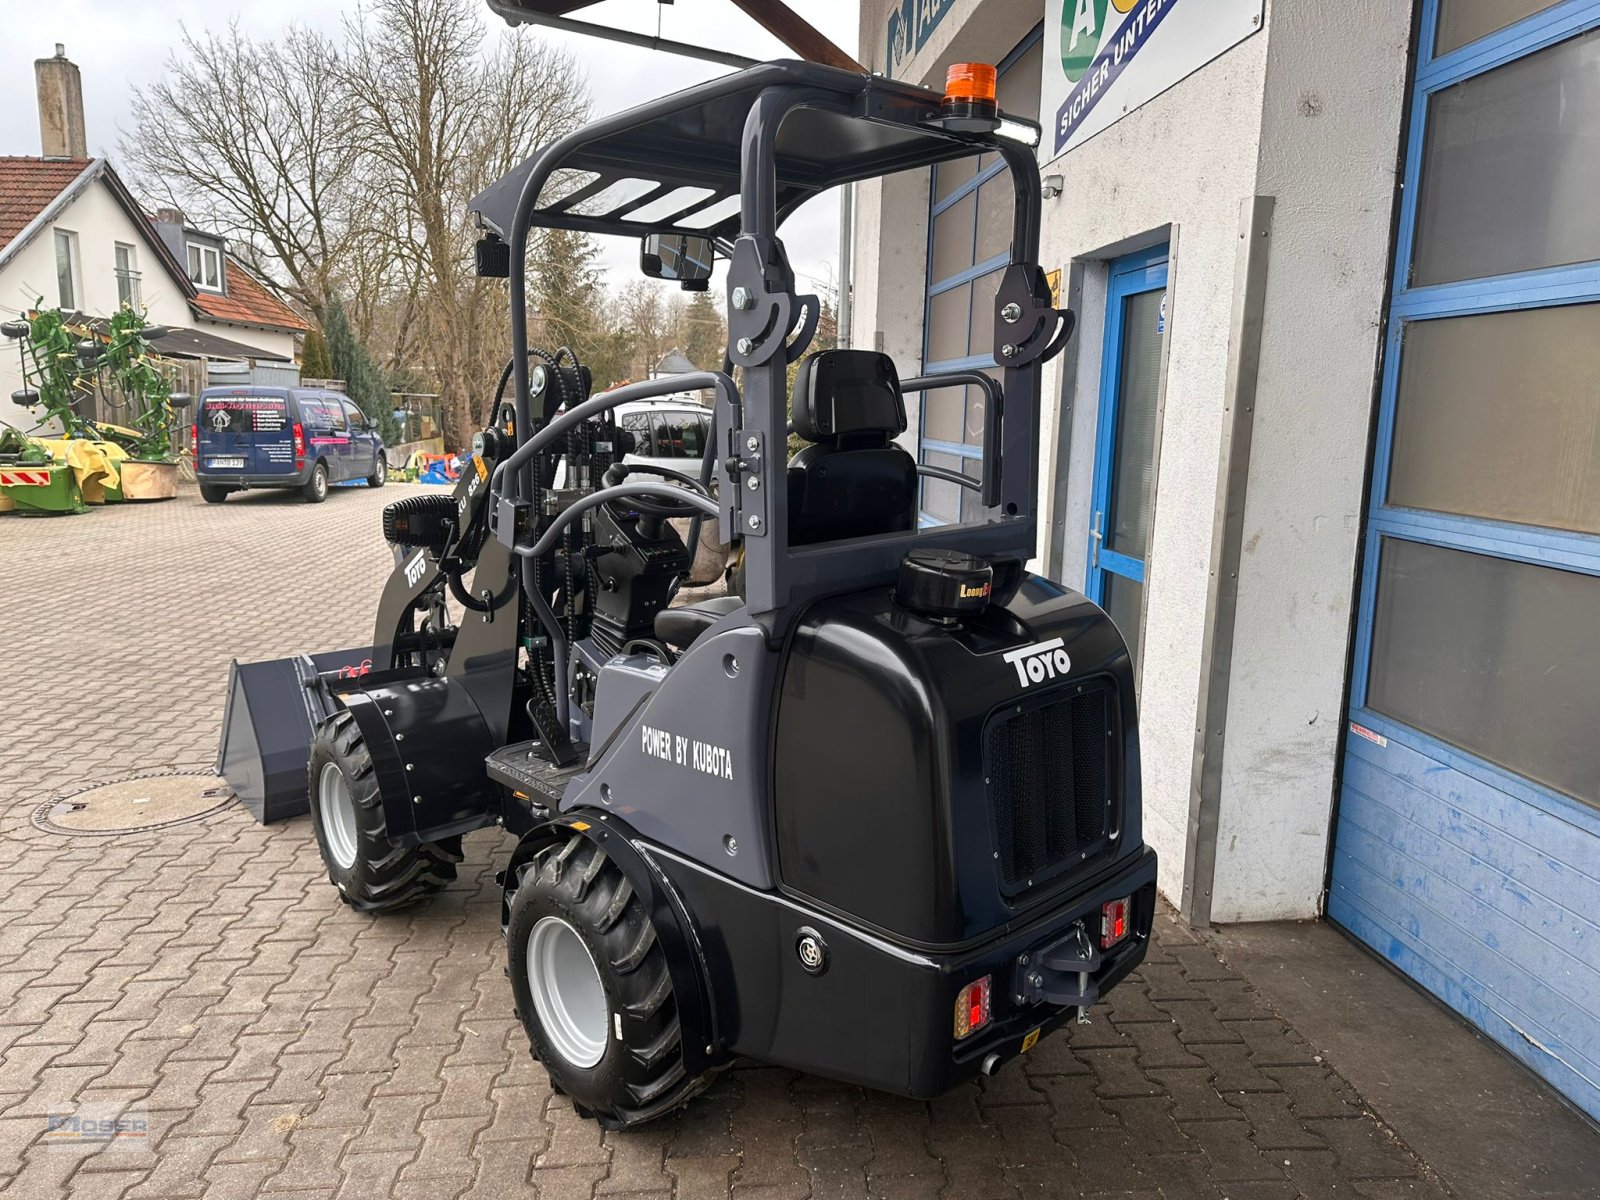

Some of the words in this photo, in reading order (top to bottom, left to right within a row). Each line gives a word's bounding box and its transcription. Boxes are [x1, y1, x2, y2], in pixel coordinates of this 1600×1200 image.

[1060, 57, 1109, 136] SICHER
[1113, 0, 1166, 66] UNTE
[641, 725, 672, 762] POWER
[675, 735, 689, 767] BY
[692, 740, 734, 781] KUBOTA
